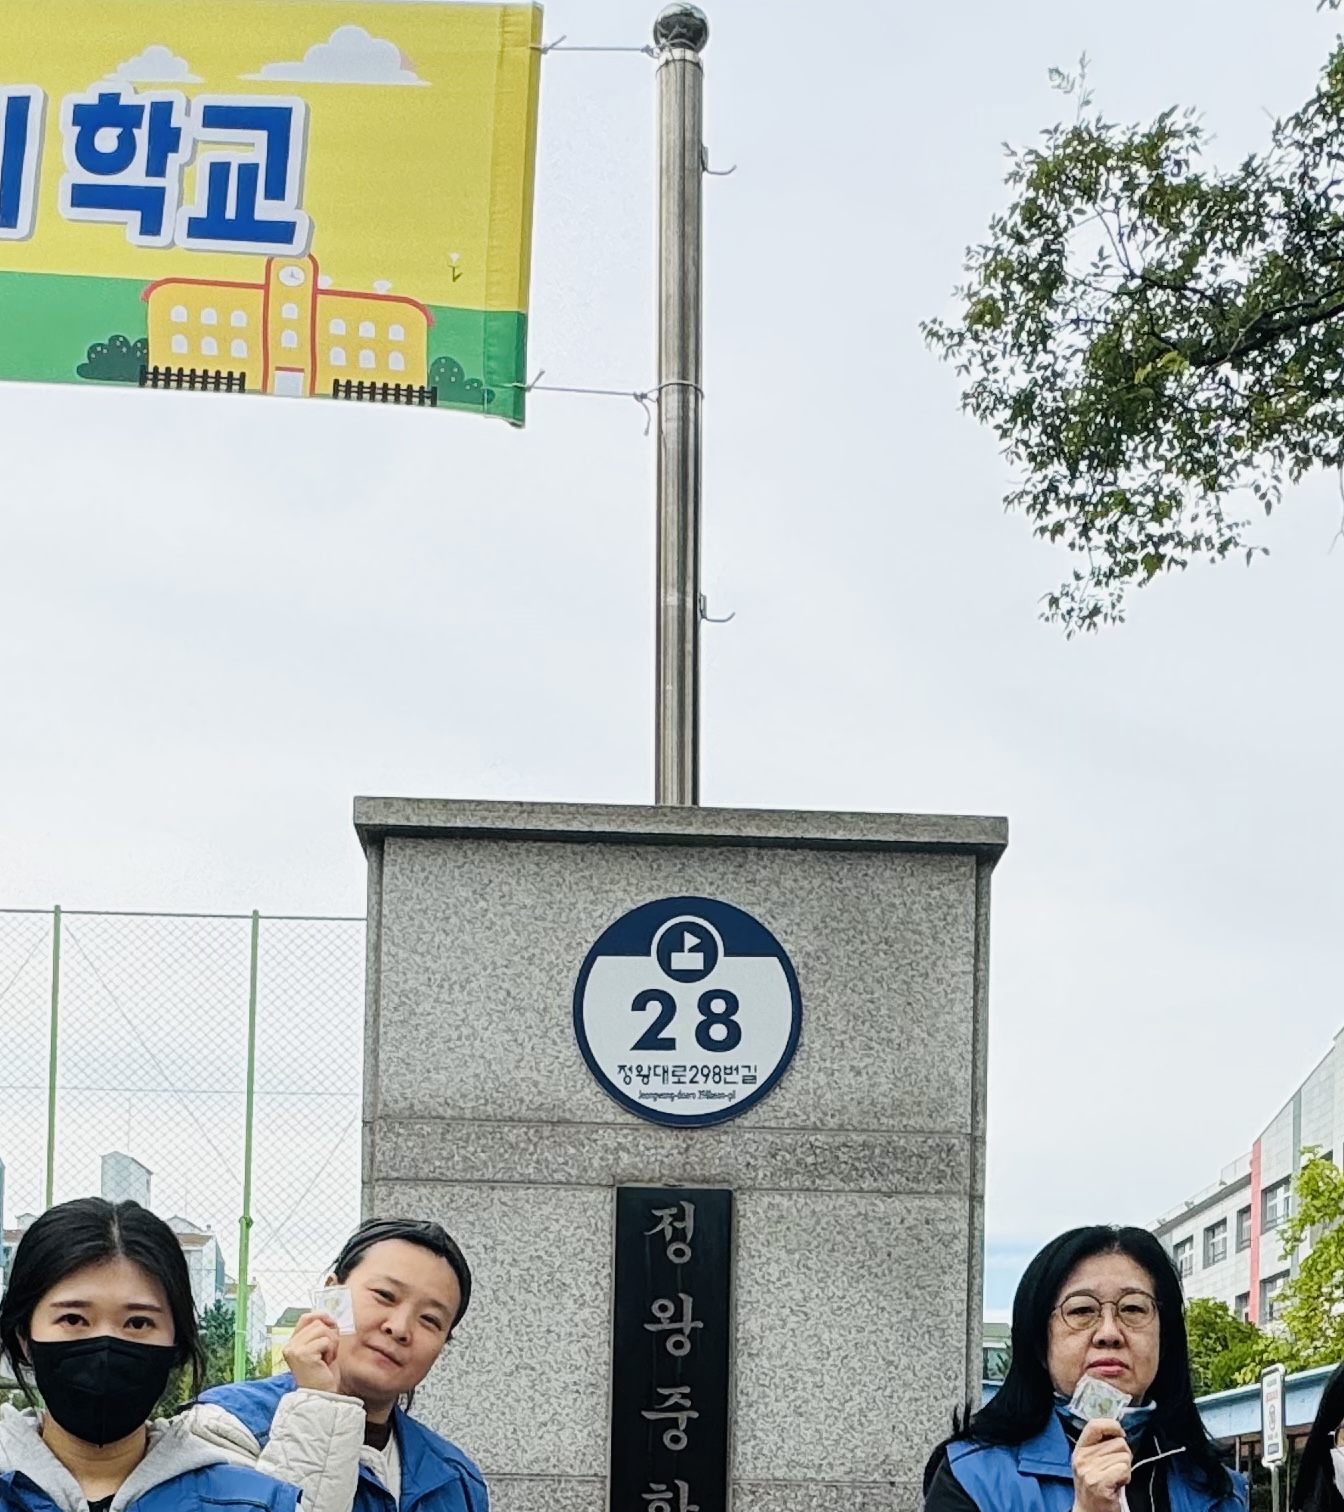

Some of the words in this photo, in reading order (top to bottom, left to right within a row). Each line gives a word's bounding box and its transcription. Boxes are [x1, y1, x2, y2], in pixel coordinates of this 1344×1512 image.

[69, 92, 298, 245] 학교
[630, 989, 742, 1052] 28
[617, 1064, 758, 1085] 정왕대로298번길
